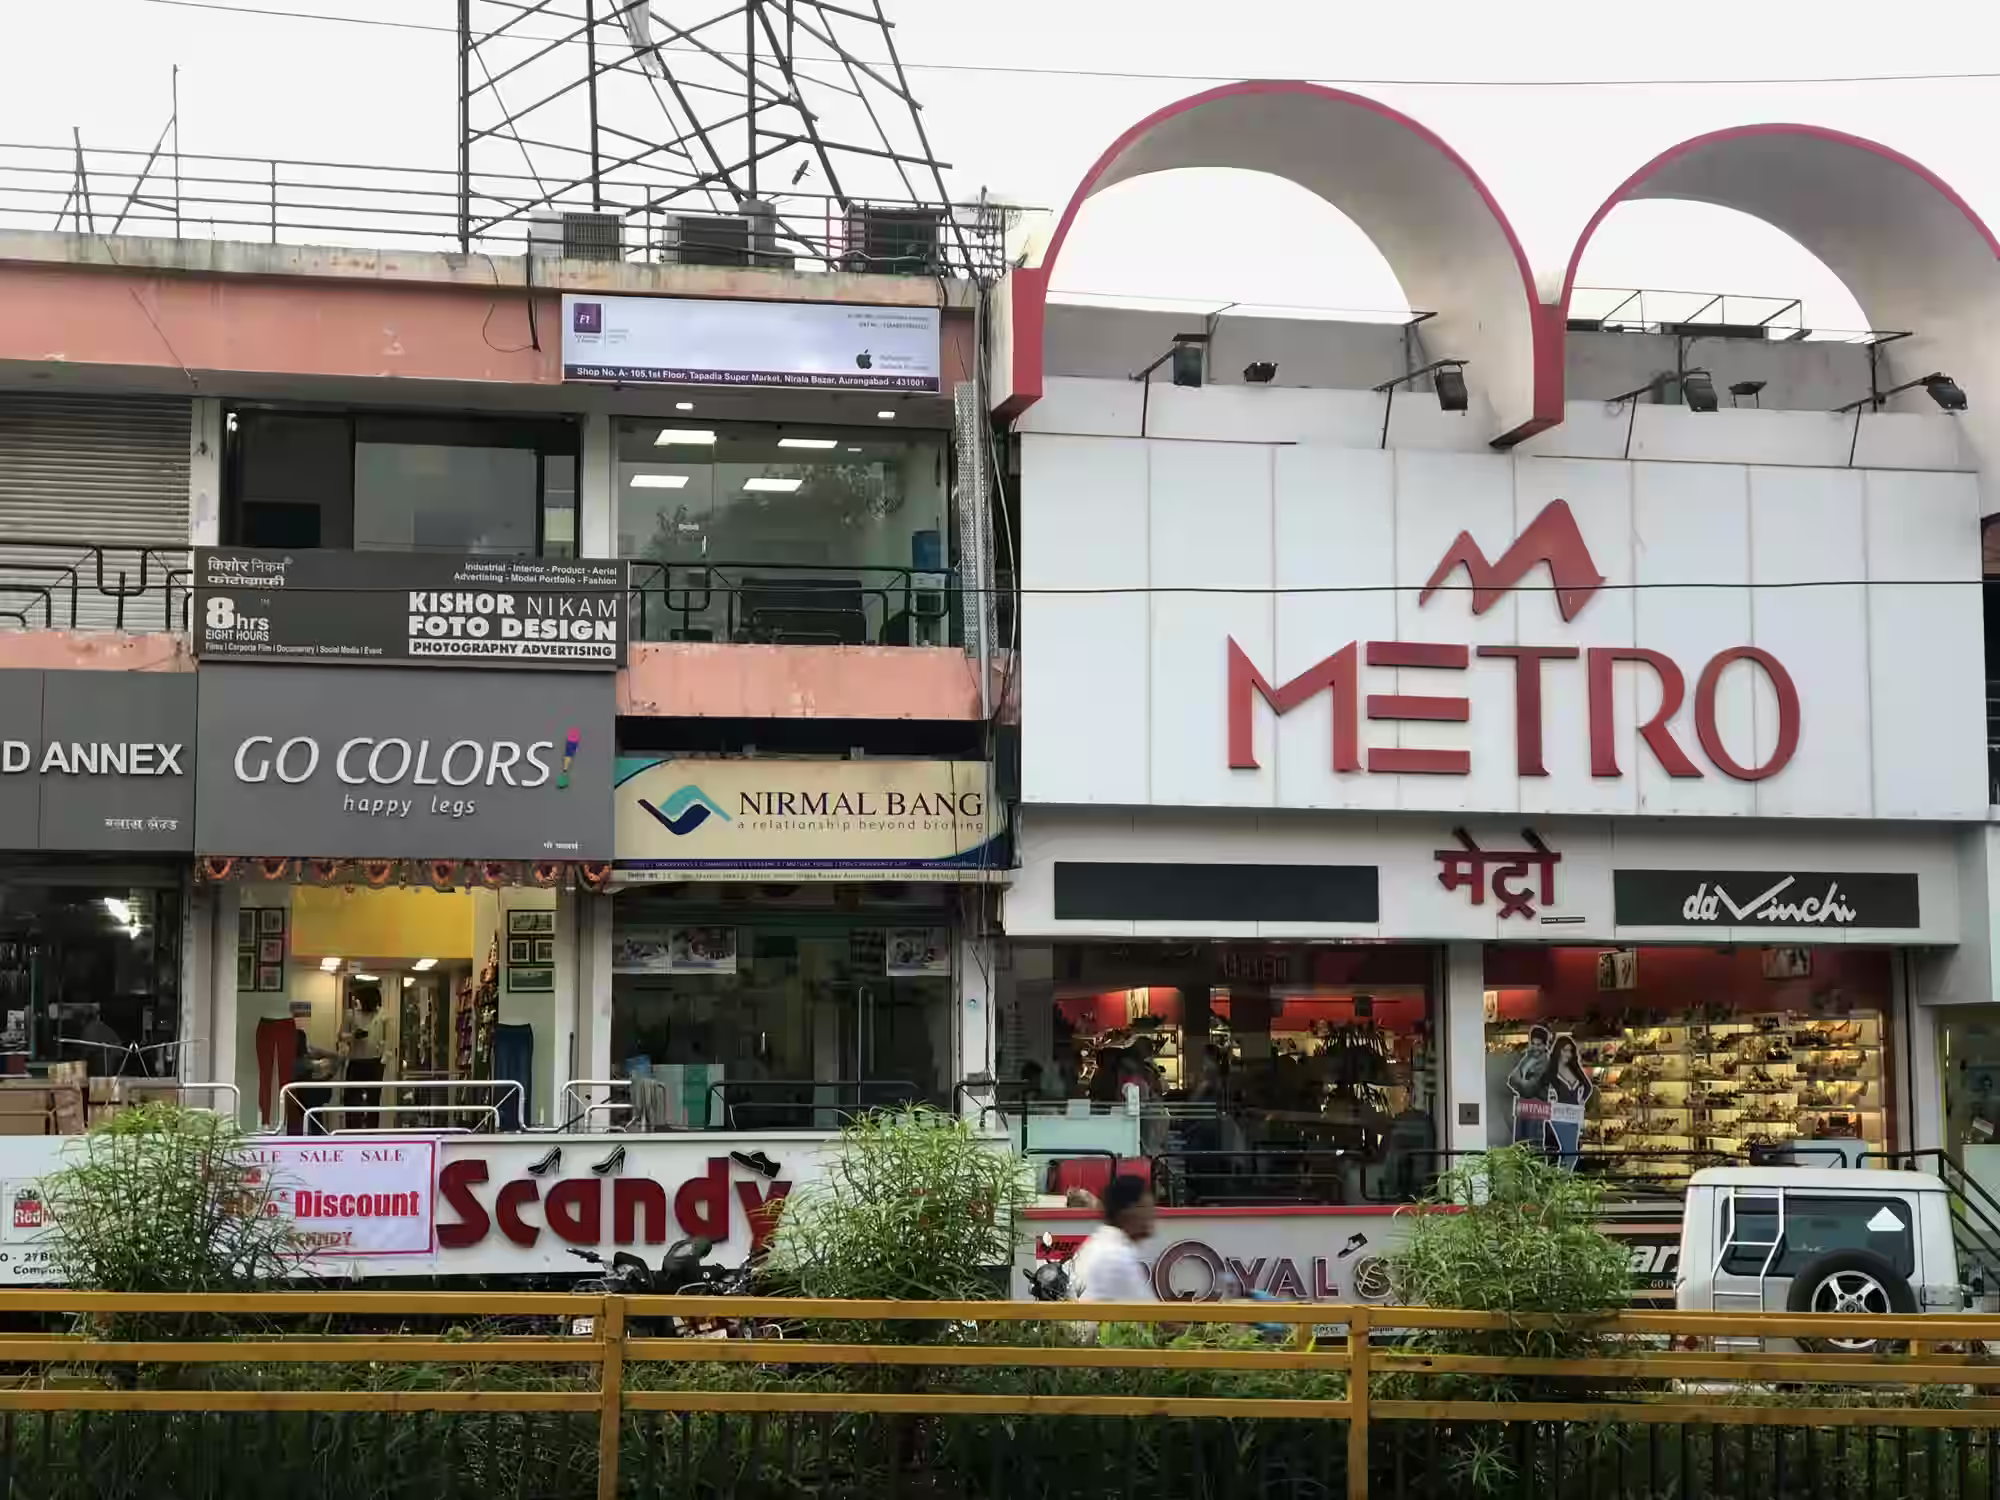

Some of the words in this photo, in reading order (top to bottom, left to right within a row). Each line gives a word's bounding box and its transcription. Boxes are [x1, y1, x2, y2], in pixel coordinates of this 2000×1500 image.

[577, 367, 600, 378] Shop
[602, 368, 617, 377] No.
[663, 370, 688, 380] Floor,
[690, 371, 722, 382] Tapadia
[725, 373, 749, 383] Super
[751, 373, 783, 384] Market,
[784, 375, 809, 384] Nirala
[811, 375, 837, 385] Bazar,
[839, 376, 889, 387] Aurangabad
[207, 556, 249, 572] किशोर
[250, 557, 285, 574] निकम
[464, 562, 506, 572] Industrial
[512, 564, 545, 573] Interior
[551, 565, 586, 575] Product
[592, 566, 617, 576] Aerial
[453, 572, 504, 584] Advertising
[511, 573, 537, 583] Model
[539, 574, 576, 584] Portfolio
[583, 576, 617, 586] Fashion
[408, 591, 516, 615] KISHOR
[527, 596, 617, 618] NIKAM
[206, 628, 234, 641] EIGHT
[236, 630, 270, 642] HOURS
[408, 615, 490, 638] FOTO
[501, 617, 617, 641] DESIGN
[319, 645, 341, 655] Social
[412, 640, 519, 655] PHOTOGRAPHY
[521, 643, 613, 657] ADVERTISING
[1227, 634, 1801, 782] METRO
[2, 741, 31, 773] D
[40, 740, 185, 777] ANNEX
[233, 734, 321, 784] GO
[343, 793, 413, 818] happy
[430, 794, 477, 817] legs
[738, 791, 879, 816] NIRMAL
[886, 791, 984, 817] BANG
[737, 821, 745, 830] a
[752, 818, 851, 833] relationship
[858, 818, 916, 832] beyond
[1434, 826, 1562, 920] मेट्रो
[238, 1151, 281, 1164] SALE
[299, 1150, 343, 1164] SALE
[360, 1149, 404, 1163] SALE
[295, 1189, 420, 1218] Discount
[435, 1156, 793, 1255] Scandy
